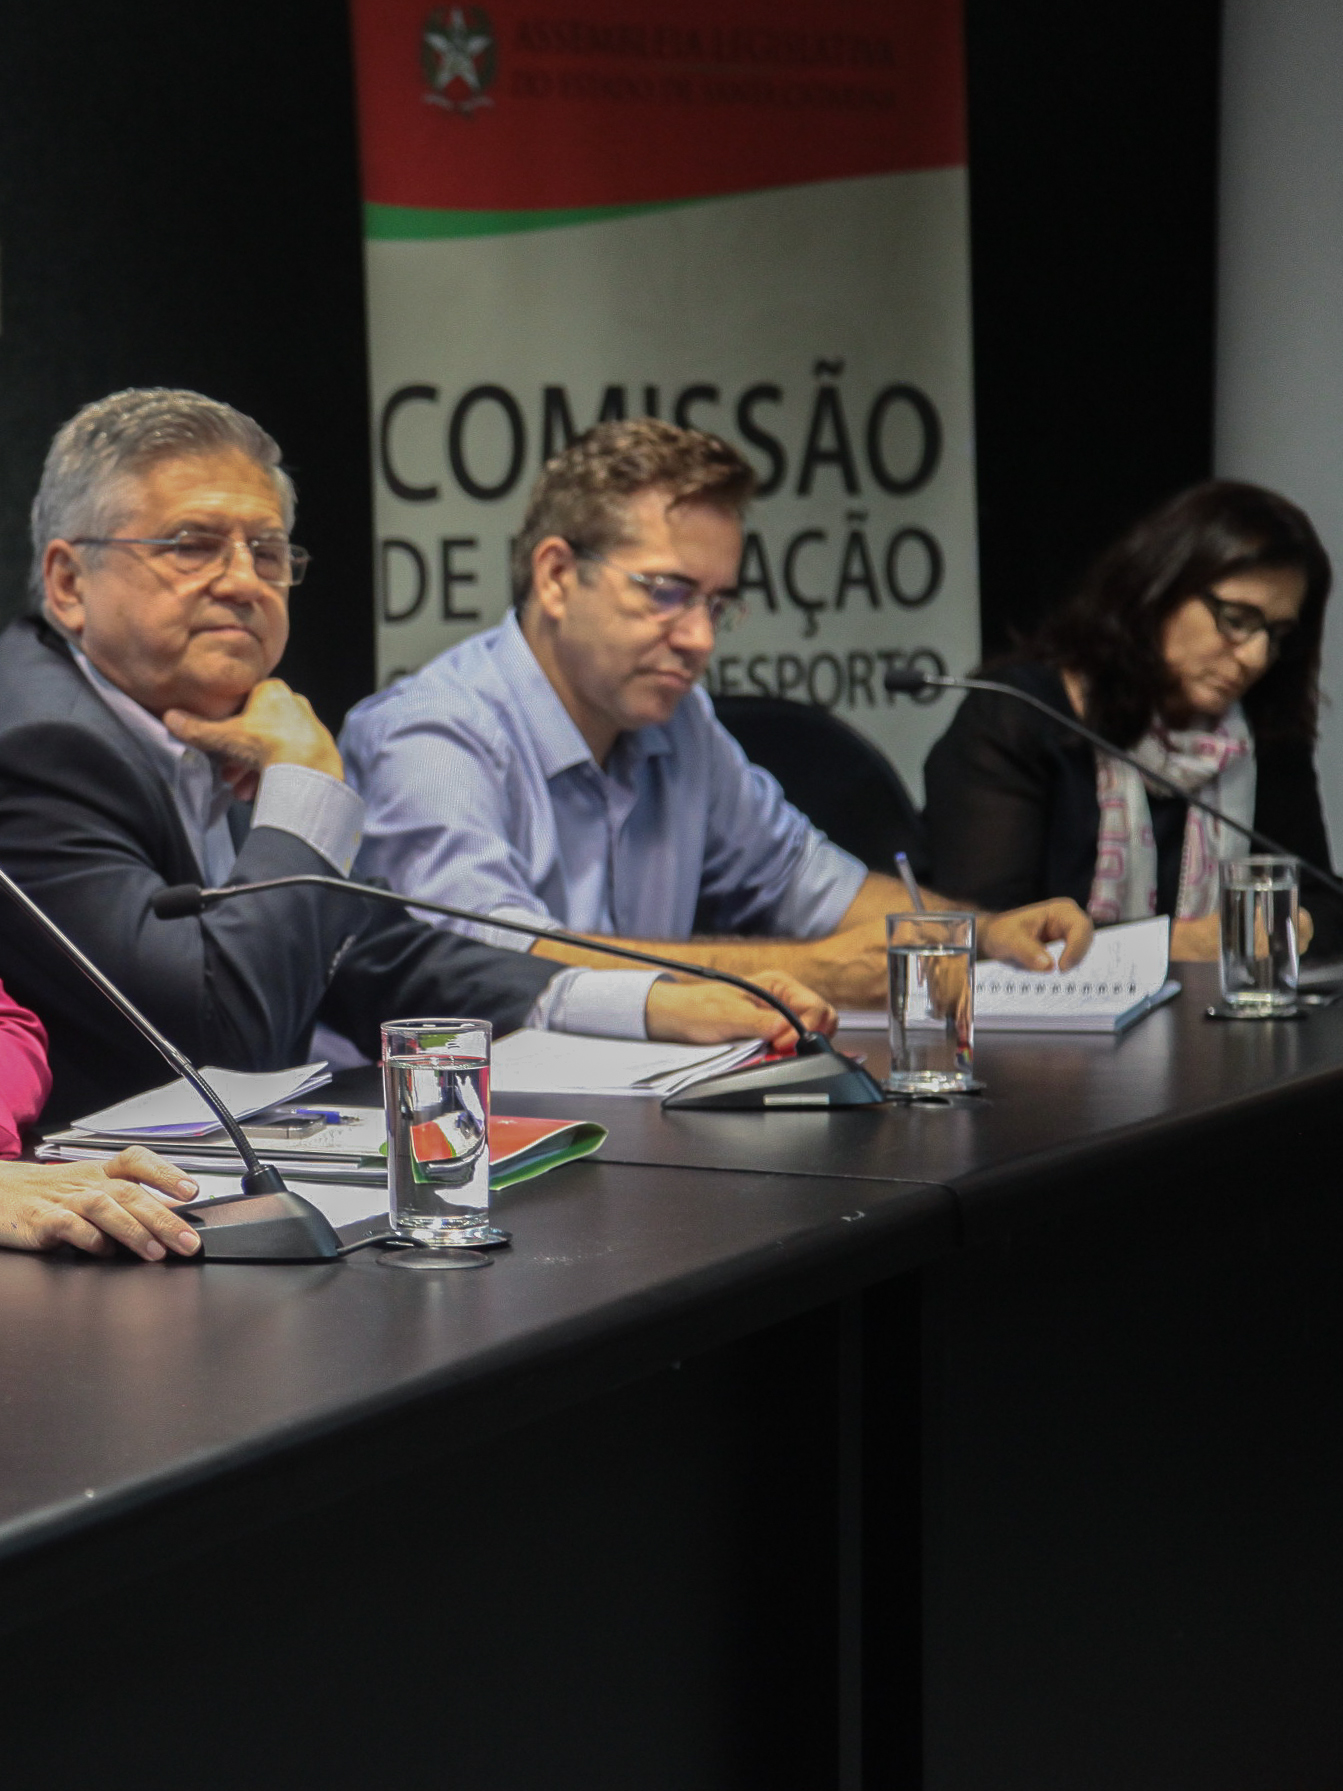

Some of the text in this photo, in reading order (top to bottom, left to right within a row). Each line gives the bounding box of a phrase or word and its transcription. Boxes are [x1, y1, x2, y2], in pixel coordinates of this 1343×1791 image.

[381, 360, 942, 500] COMSÃO
[382, 537, 479, 622] DE
[702, 648, 948, 707] ESPORTO
